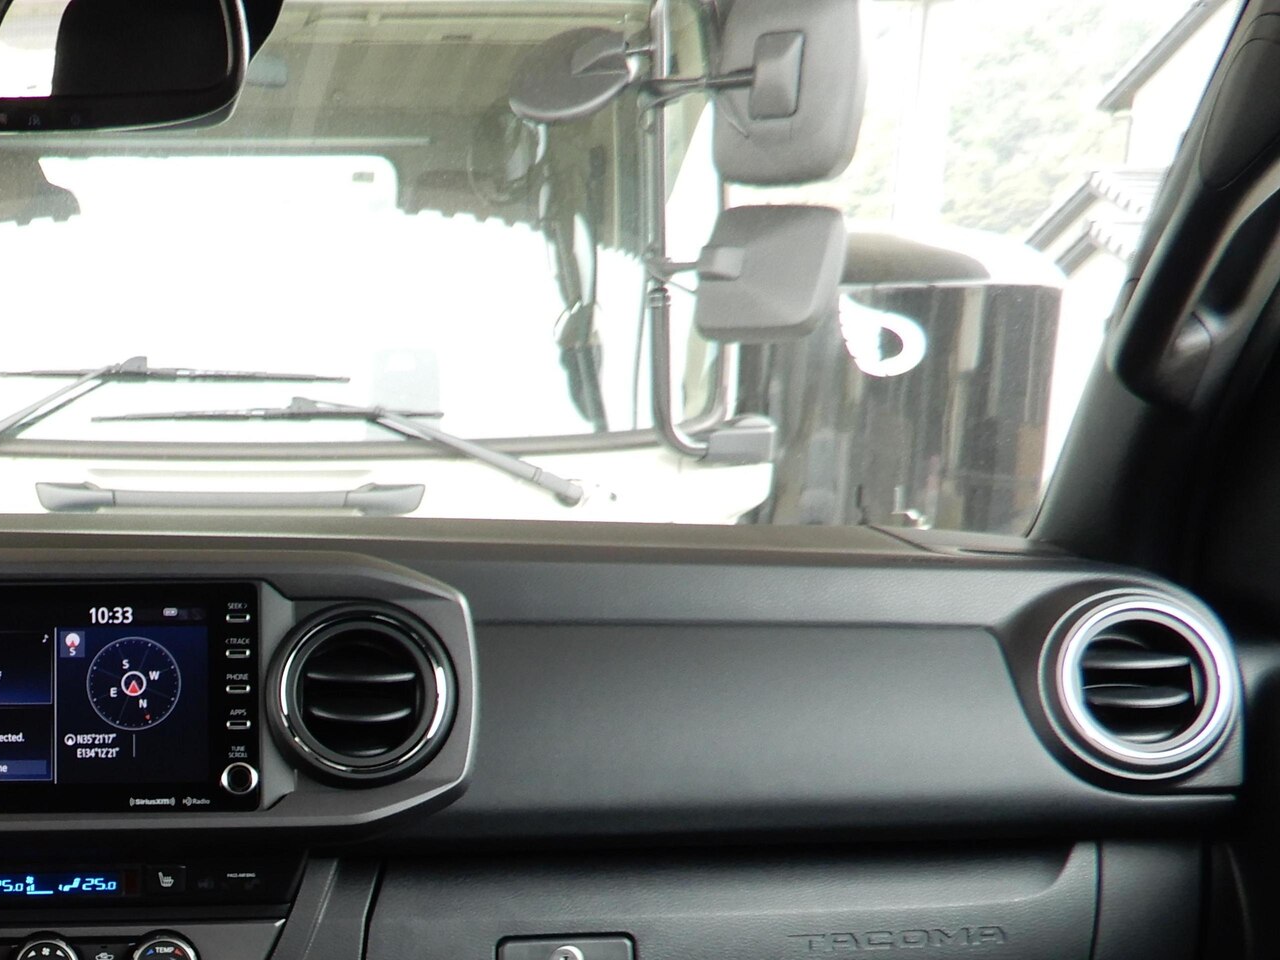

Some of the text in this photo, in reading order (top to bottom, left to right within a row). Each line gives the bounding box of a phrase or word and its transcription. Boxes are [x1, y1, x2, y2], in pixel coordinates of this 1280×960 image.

[89, 607, 133, 624] 10:33
[122, 659, 130, 669] S
[149, 671, 160, 681] W
[110, 687, 117, 697] E
[139, 699, 148, 708] N
[82, 878, 117, 890] 25.0
[787, 925, 1007, 950] TACOMA
[154, 946, 175, 954] TEMP
